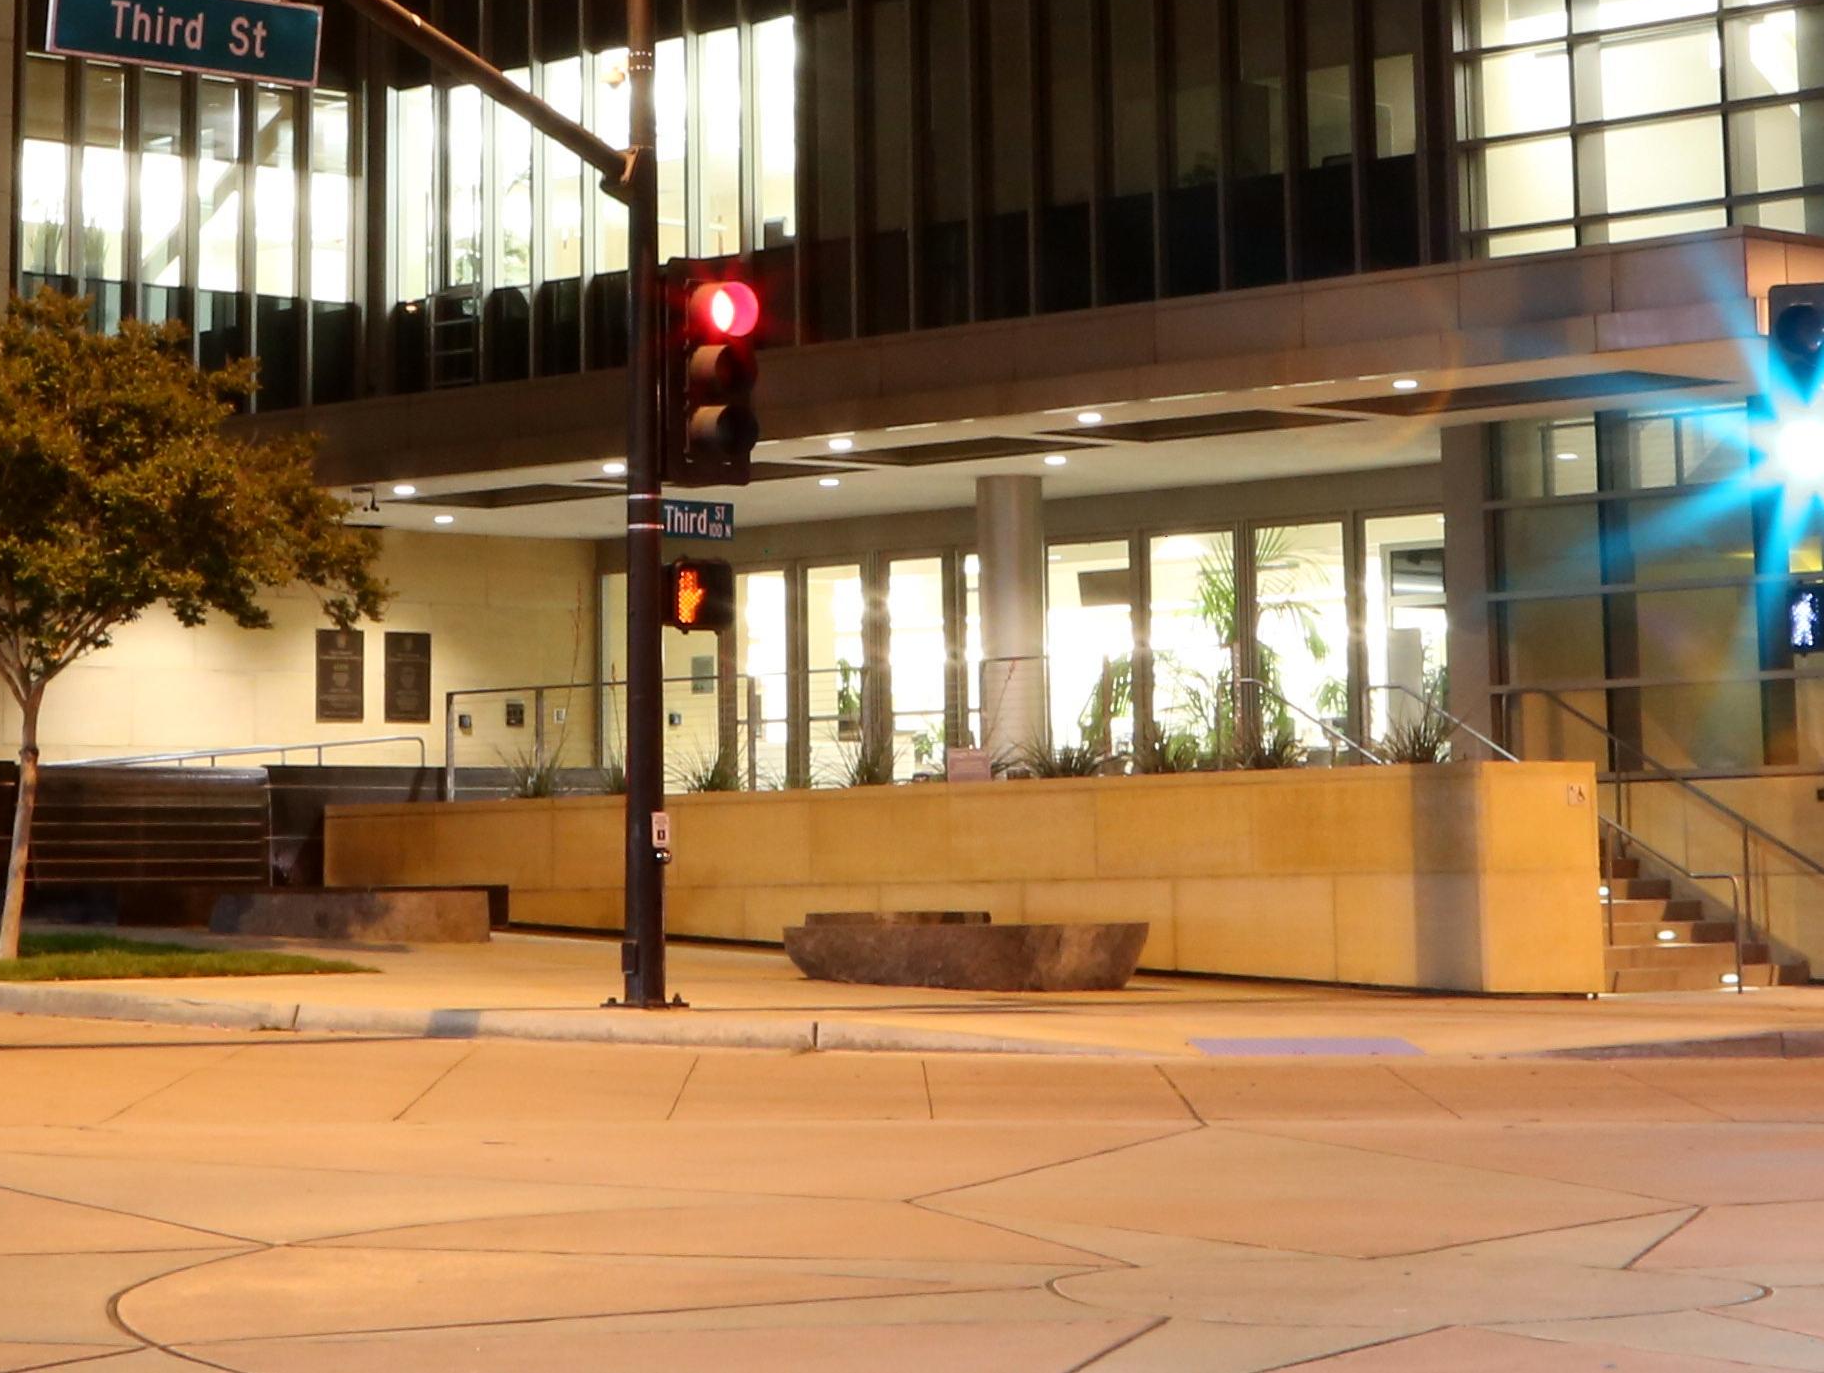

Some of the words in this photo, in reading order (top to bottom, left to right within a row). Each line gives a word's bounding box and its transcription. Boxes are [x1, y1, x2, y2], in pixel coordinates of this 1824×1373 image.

[111, 0, 204, 50] Third
[229, 16, 267, 58] St
[664, 504, 707, 535] Third
[715, 505, 725, 521] ST
